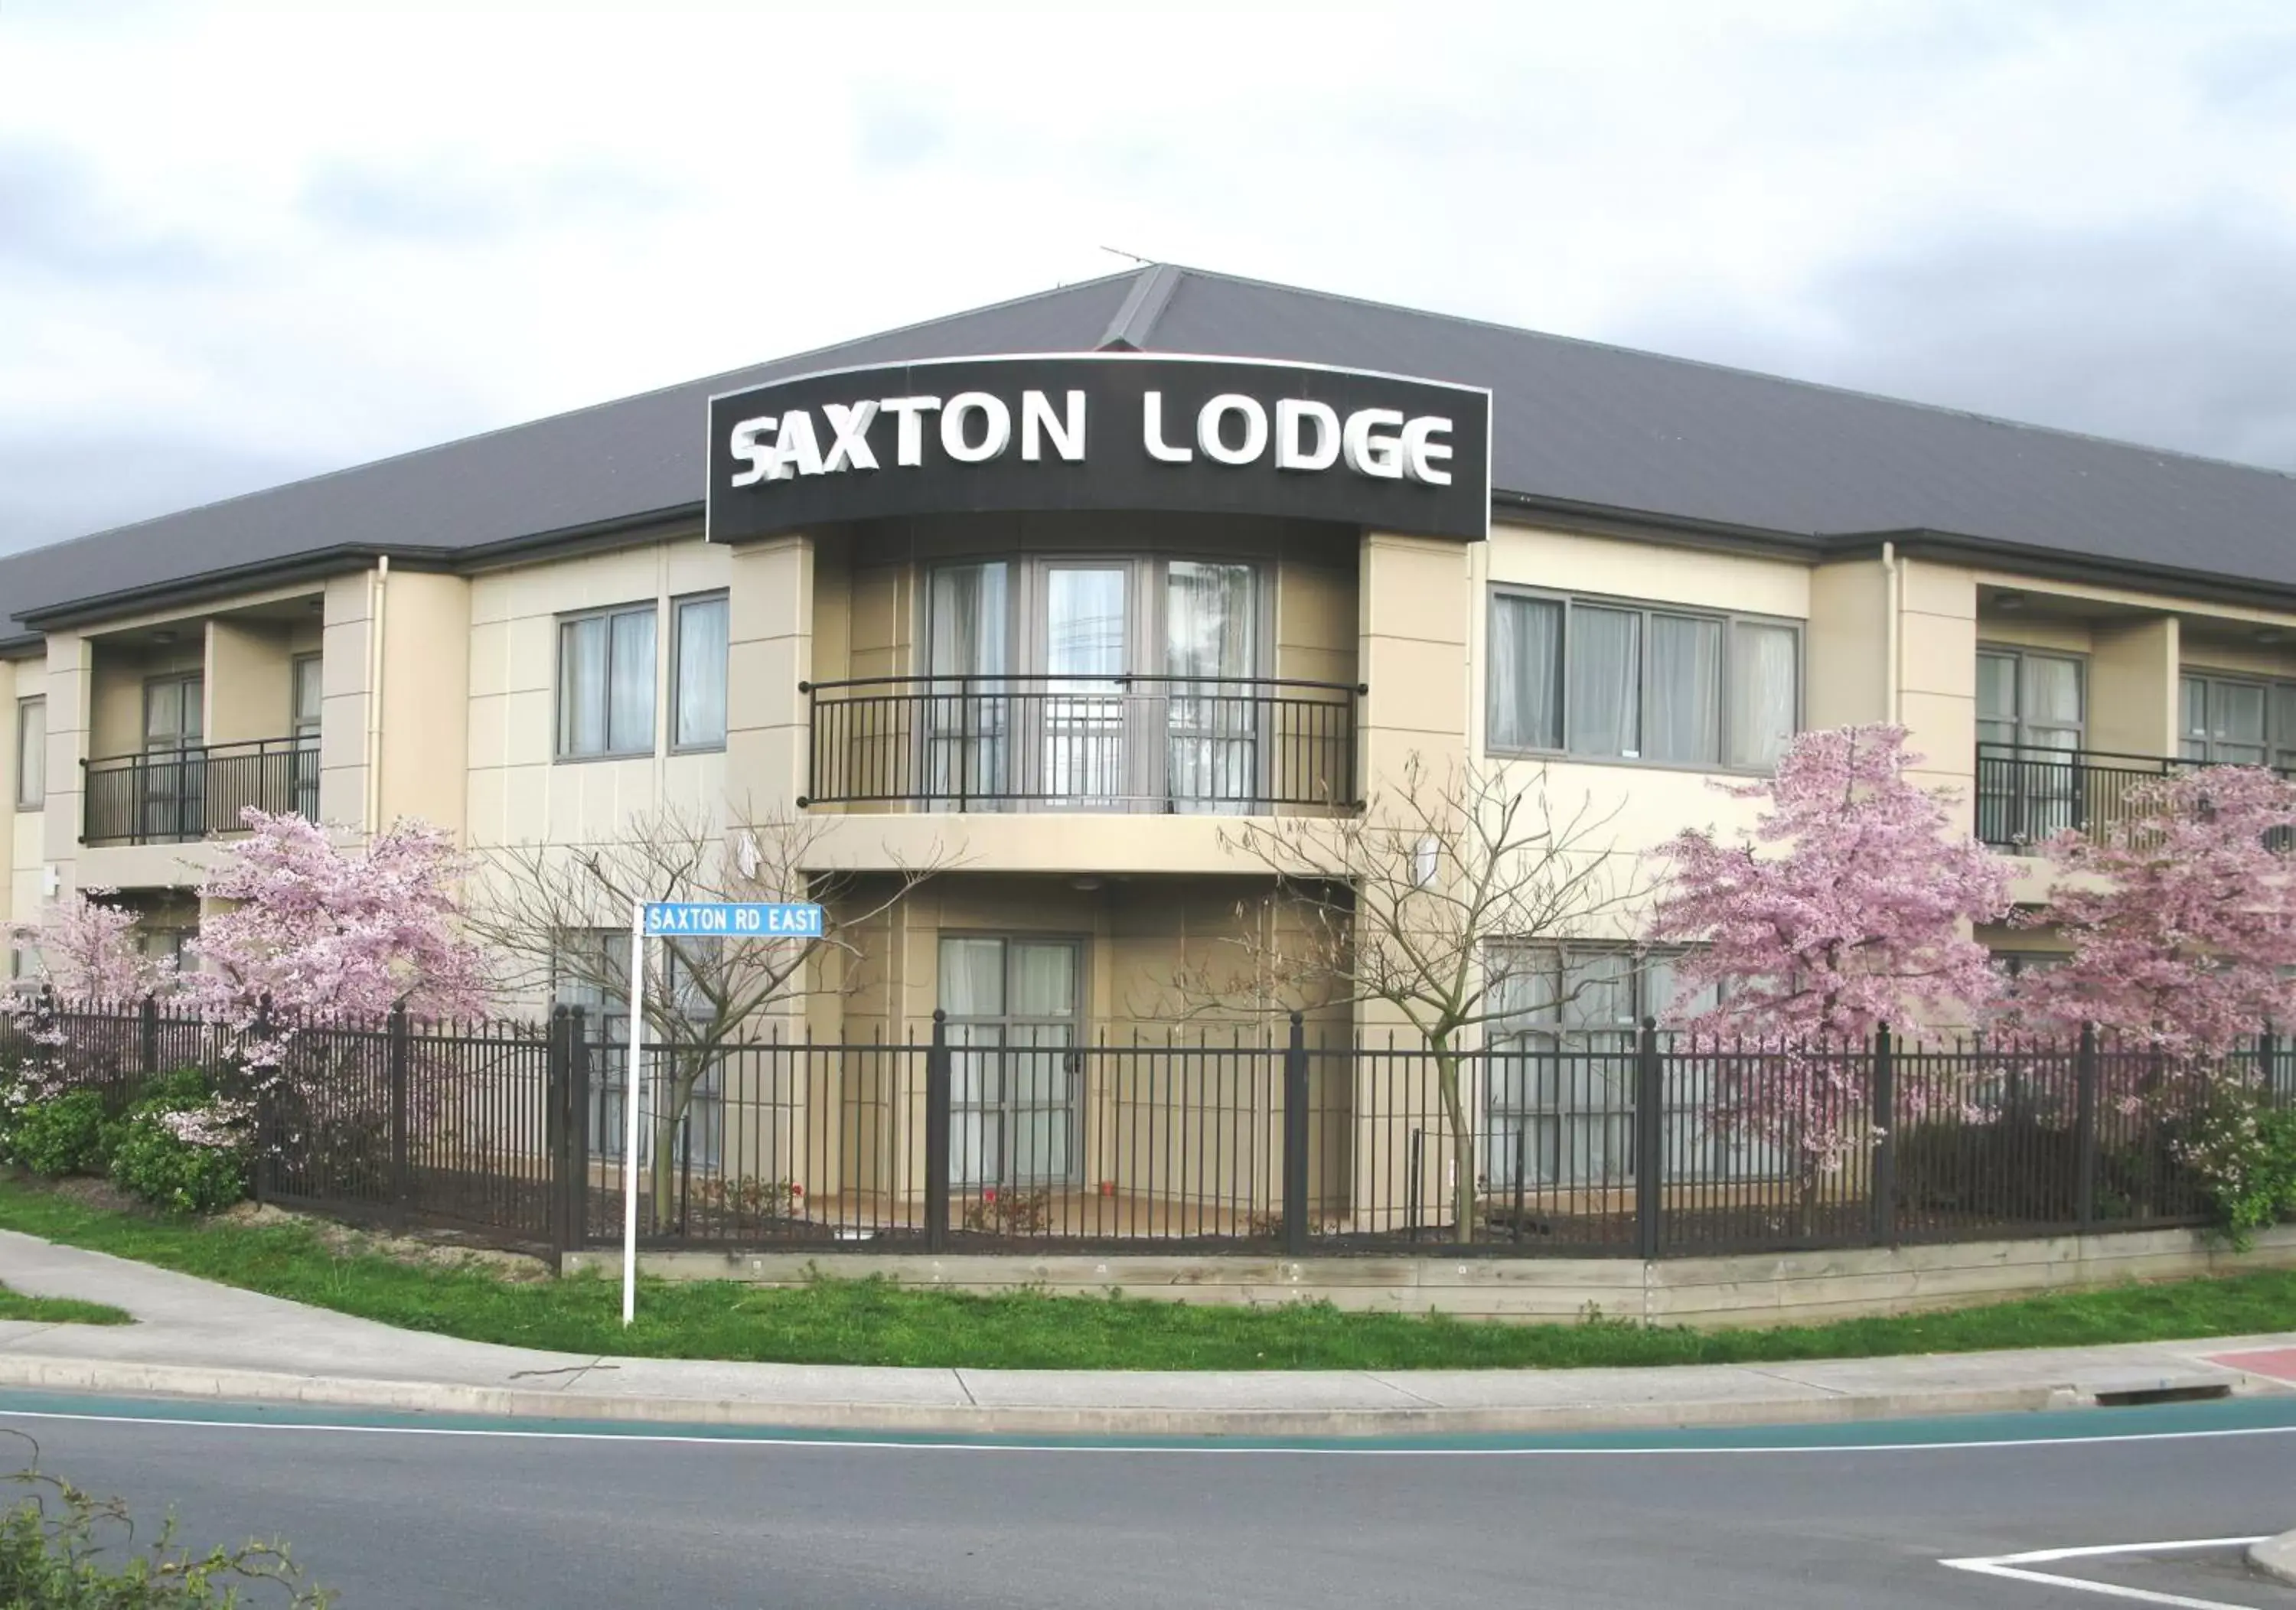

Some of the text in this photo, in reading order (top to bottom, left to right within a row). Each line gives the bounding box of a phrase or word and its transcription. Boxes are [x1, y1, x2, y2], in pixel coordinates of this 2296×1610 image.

[730, 390, 1453, 488] SAXTON LODGE
[650, 908, 819, 931] SAXTON RD EAST
